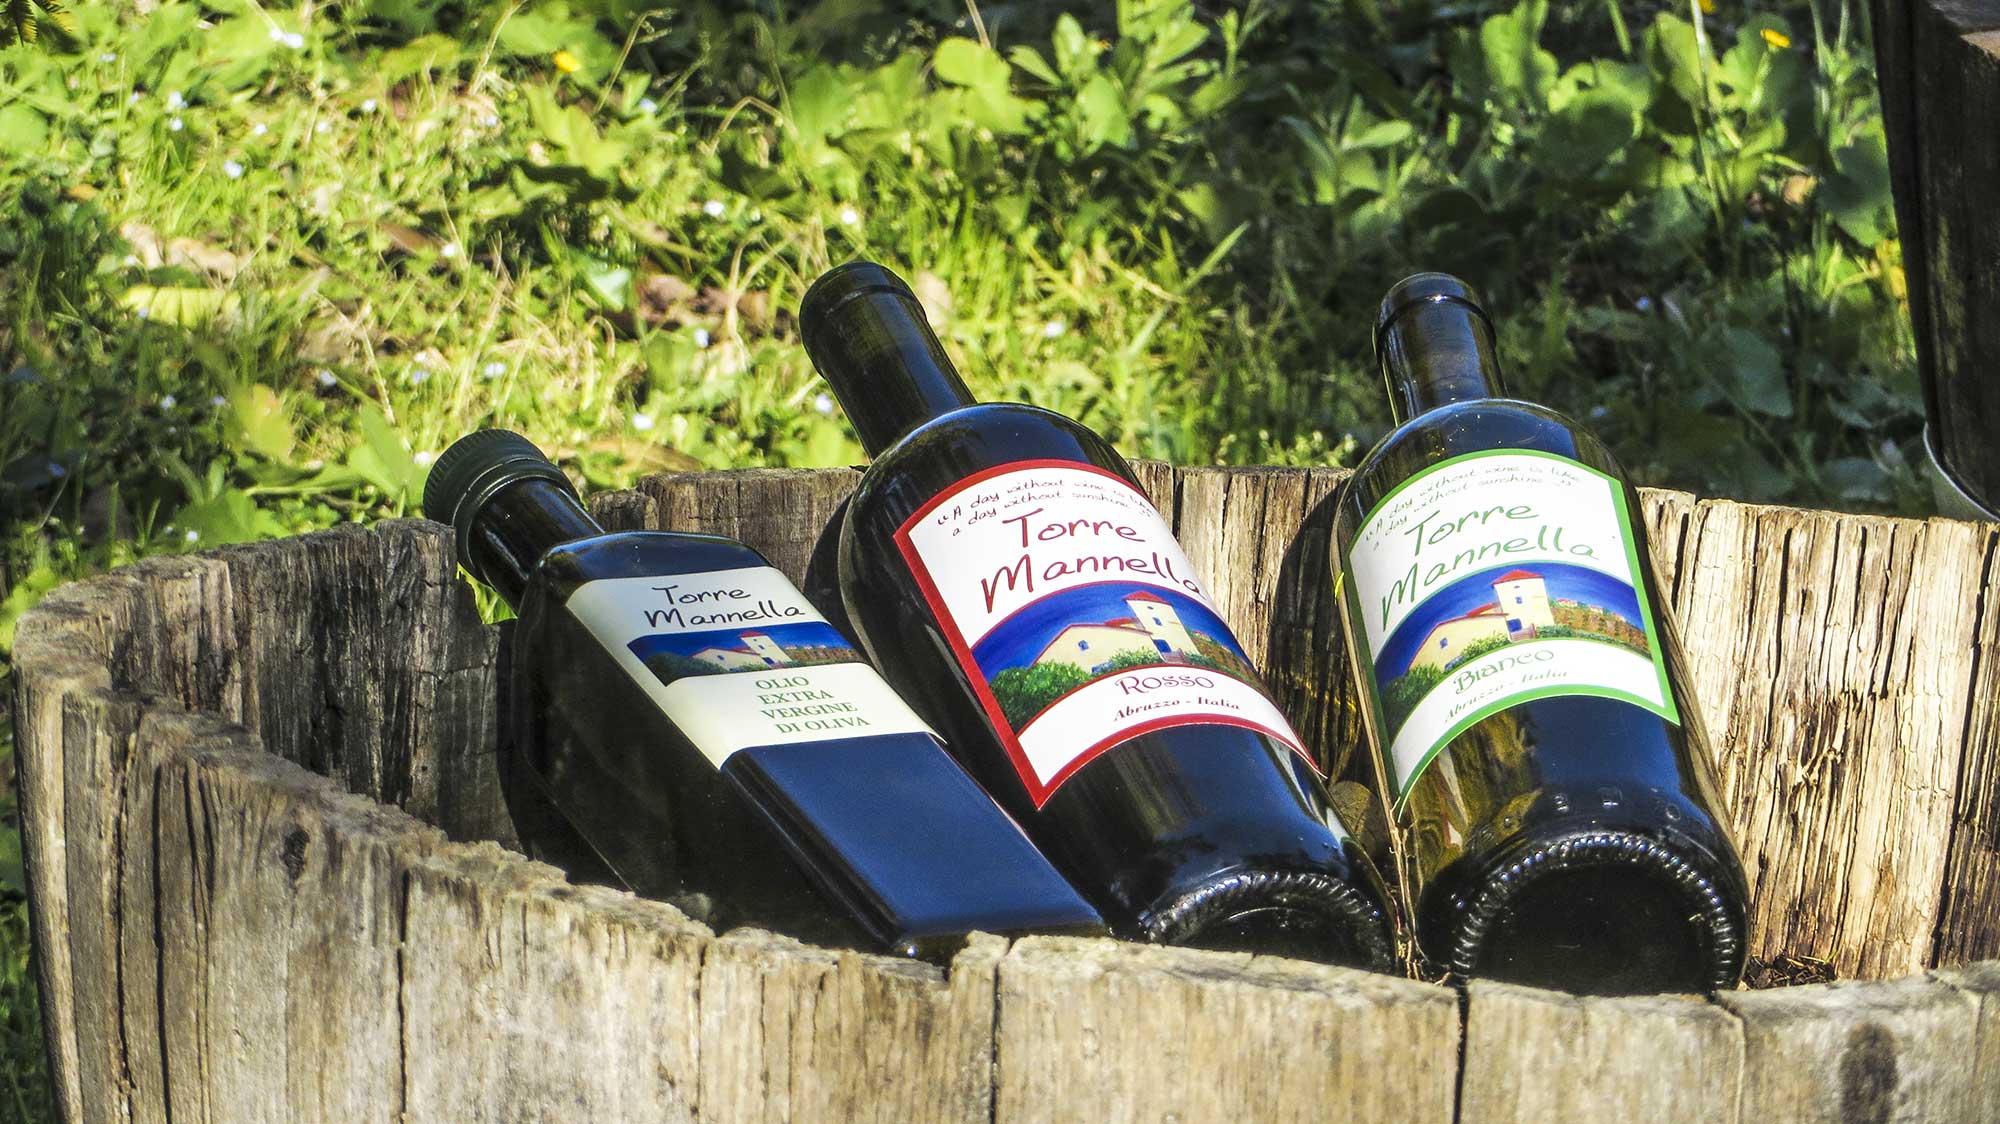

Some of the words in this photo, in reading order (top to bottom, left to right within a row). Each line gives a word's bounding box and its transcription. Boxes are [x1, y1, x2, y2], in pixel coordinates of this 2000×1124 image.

[970, 492, 1000, 509] day
[1007, 479, 1063, 494] without
[1385, 514, 1408, 537] day
[1413, 481, 1470, 513] without
[1389, 498, 1413, 519] day
[1419, 468, 1475, 497] without
[952, 527, 961, 537] a
[968, 507, 998, 525] day
[1004, 491, 1063, 508] without
[1002, 508, 1146, 548] Torre
[1403, 504, 1540, 557] Torre
[651, 585, 751, 605] Torre
[981, 551, 1207, 614] Mannella
[1382, 525, 1600, 632] Mannella
[643, 600, 806, 628] Mannella
[755, 676, 810, 690] OLIO
[1453, 649, 1554, 695] Bianco
[758, 689, 834, 705] EXTRA
[760, 702, 858, 720] VERGINE
[1113, 698, 1181, 722] Abruzzo
[1197, 696, 1241, 711] Italia
[1444, 682, 1504, 724] Abruzzo
[1521, 668, 1568, 684] Italia
[775, 722, 800, 734] DI
[804, 716, 871, 731] OLIVA
